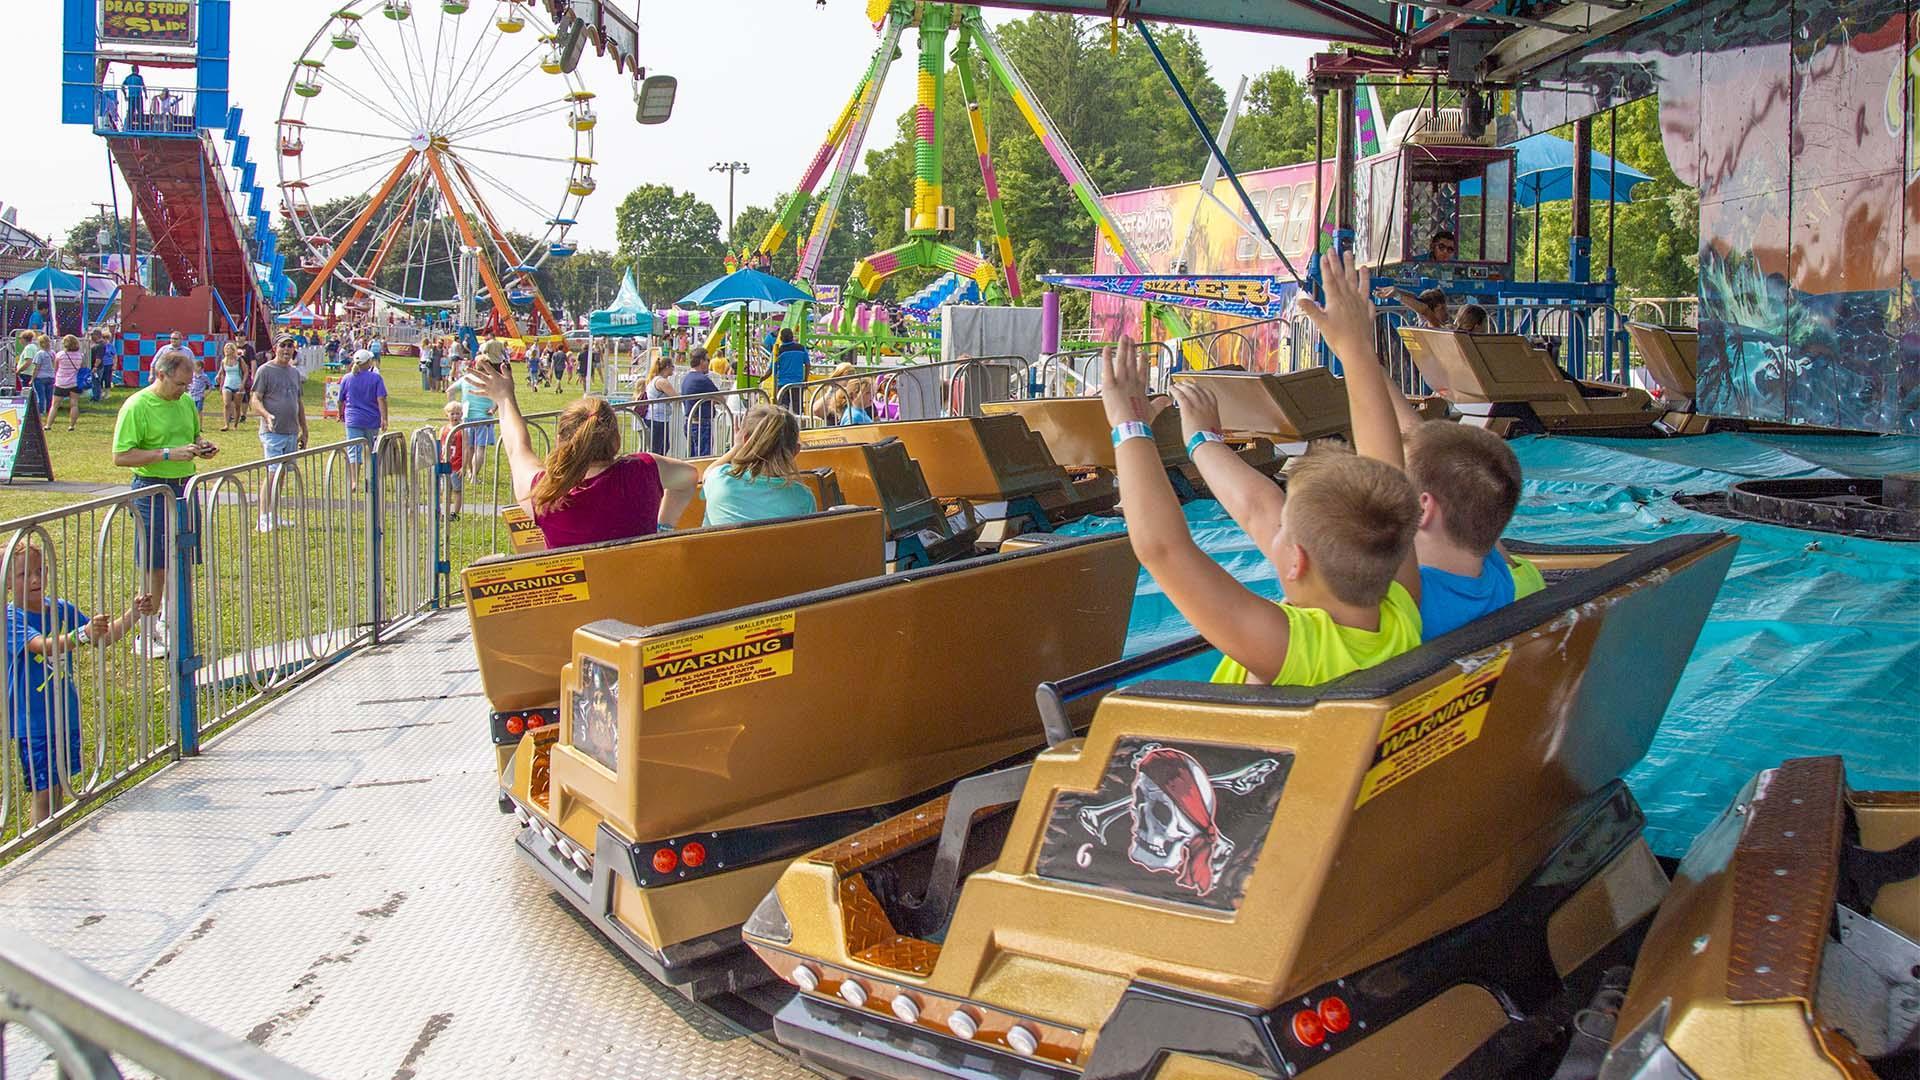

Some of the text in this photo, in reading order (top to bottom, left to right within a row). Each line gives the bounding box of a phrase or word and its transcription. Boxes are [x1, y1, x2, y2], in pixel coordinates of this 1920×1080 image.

[105, 0, 188, 15] DRAG STRIP
[125, 17, 186, 32] SLIDE
[1143, 279, 1270, 306] SIZZLER
[480, 573, 577, 595] WARNING
[734, 613, 792, 630] SMALLER PERSON
[646, 633, 703, 651] LARGER PERSON
[655, 637, 782, 678] WARNING
[675, 674, 691, 682] PULL
[729, 665, 754, 675] STARTS
[660, 694, 674, 702] AND
[718, 680, 732, 688] CAR
[692, 679, 717, 689] SEATED
[1382, 686, 1487, 758] WARNING
[1075, 843, 1094, 869] 6
